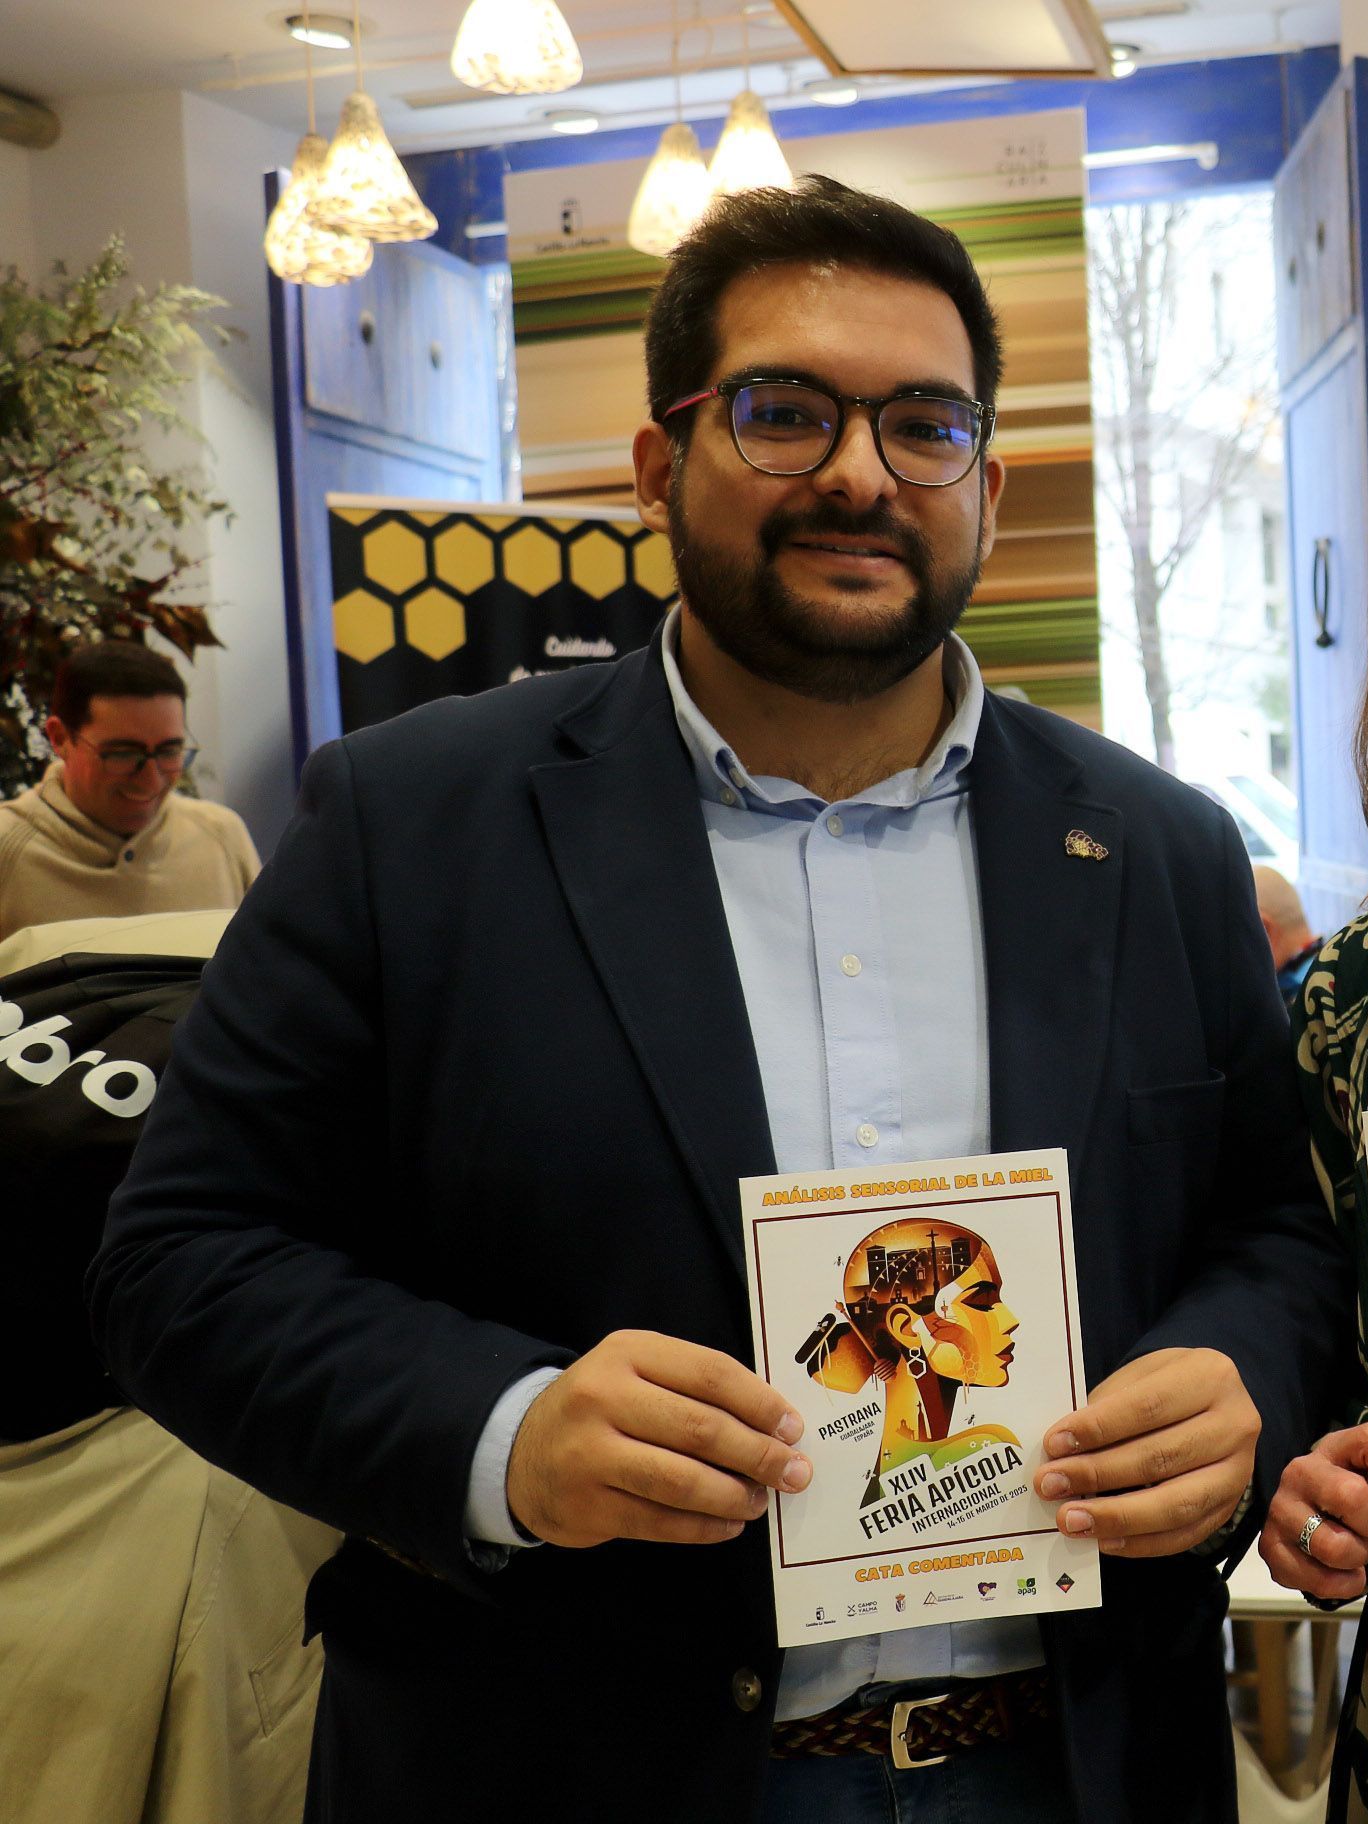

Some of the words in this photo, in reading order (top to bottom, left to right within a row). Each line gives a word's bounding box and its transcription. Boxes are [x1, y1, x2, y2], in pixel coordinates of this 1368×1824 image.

[762, 1185, 846, 1206] ANÁLISIS
[850, 1176, 950, 1198] SENSORIAL
[954, 1173, 979, 1189] DE
[982, 1171, 1006, 1187] LA
[1009, 1167, 1053, 1184] MIEL
[818, 1401, 882, 1440] PASTRANA
[859, 1492, 926, 1540] FERIA
[928, 1445, 1023, 1508] APÍCOLA
[887, 1463, 928, 1496] XLIV
[911, 1482, 1002, 1534] INTERNACIONAL
[966, 1511, 975, 1522] DE
[976, 1500, 1000, 1518] MARZO
[1000, 1494, 1010, 1507] DE
[1010, 1485, 1028, 1502] 2025
[854, 1563, 905, 1582] CATA
[908, 1547, 1024, 1575] COMENTADA
[857, 1600, 878, 1608] CAMPO
[1017, 1587, 1037, 1596] apag
